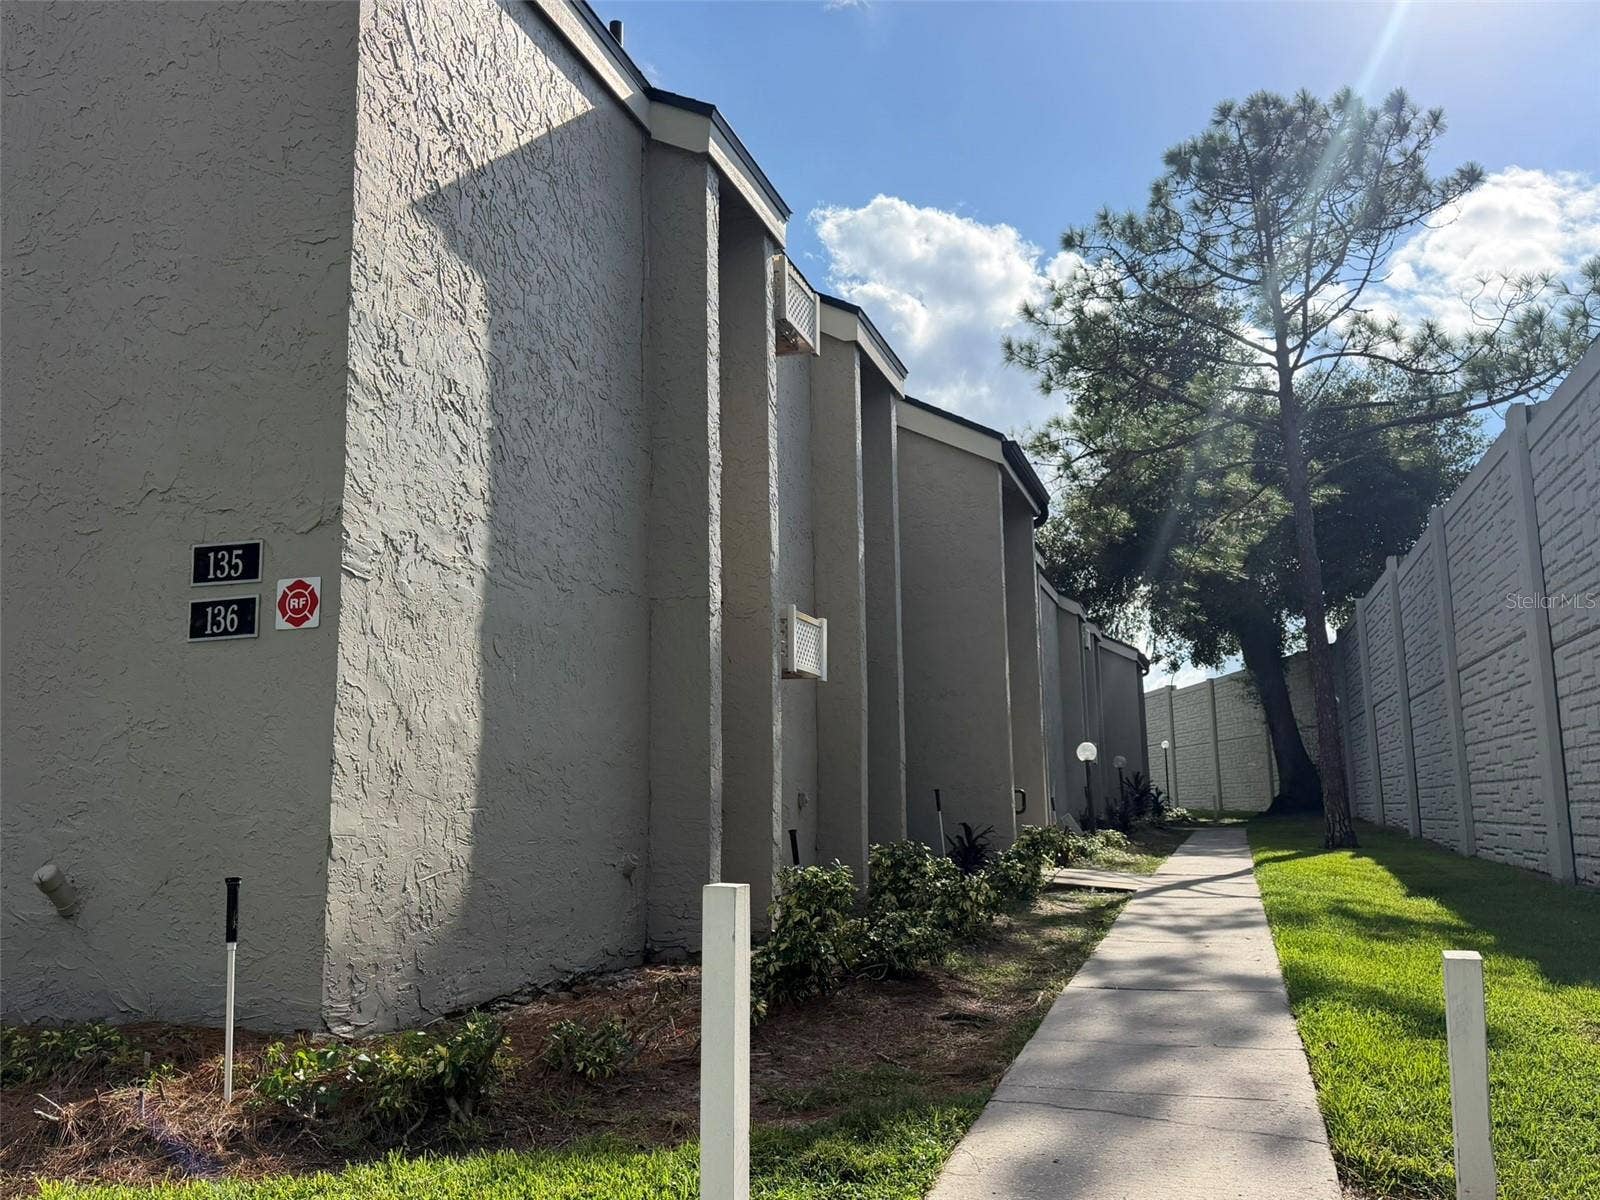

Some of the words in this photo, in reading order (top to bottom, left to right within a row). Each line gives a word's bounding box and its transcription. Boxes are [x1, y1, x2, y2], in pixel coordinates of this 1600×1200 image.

[207, 550, 243, 579] 135
[289, 597, 306, 610] RF
[204, 604, 238, 634] 136
